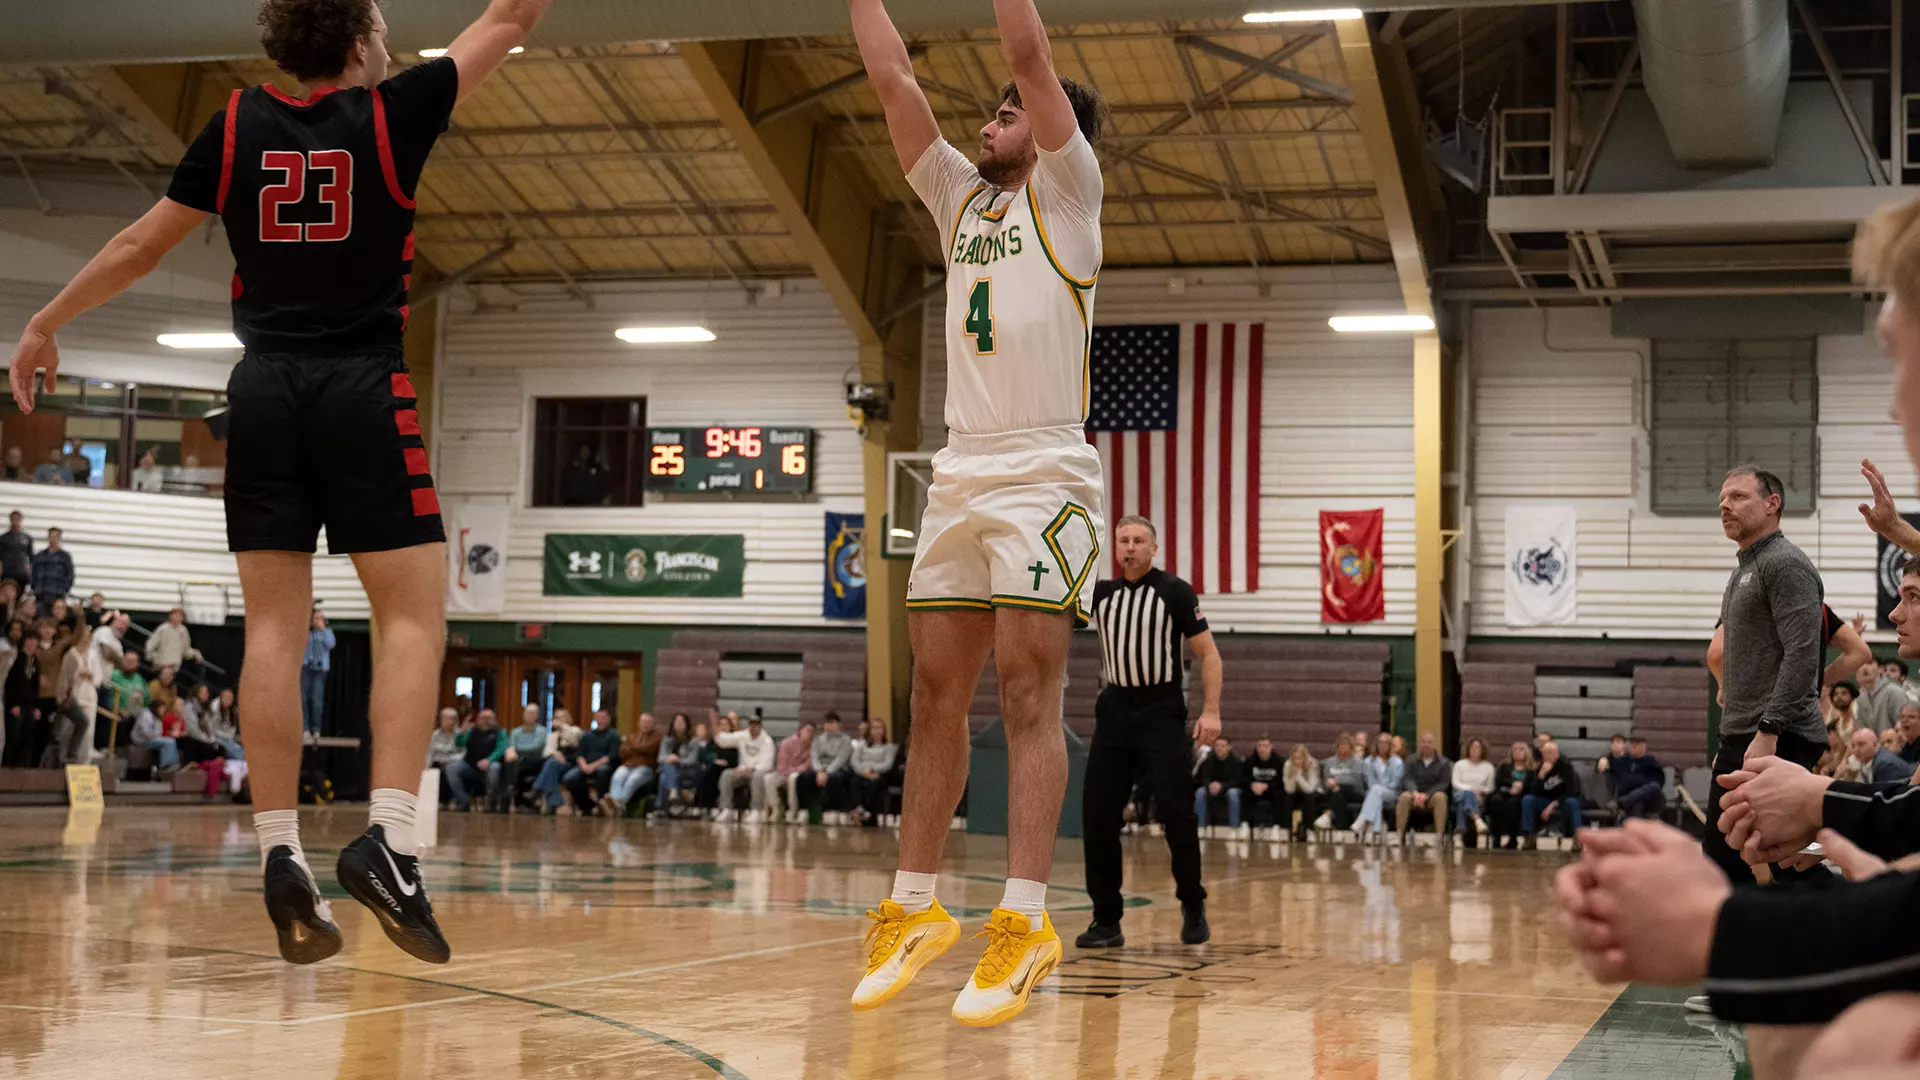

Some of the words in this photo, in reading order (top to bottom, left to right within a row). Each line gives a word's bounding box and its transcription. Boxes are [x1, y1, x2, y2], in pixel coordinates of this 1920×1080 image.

[259, 149, 353, 242] 23
[955, 225, 1022, 266] BARONS
[963, 276, 996, 356] 4
[705, 427, 762, 458] 9:46
[650, 445, 685, 475] 25
[782, 444, 806, 475] 16
[755, 468, 764, 489] 1
